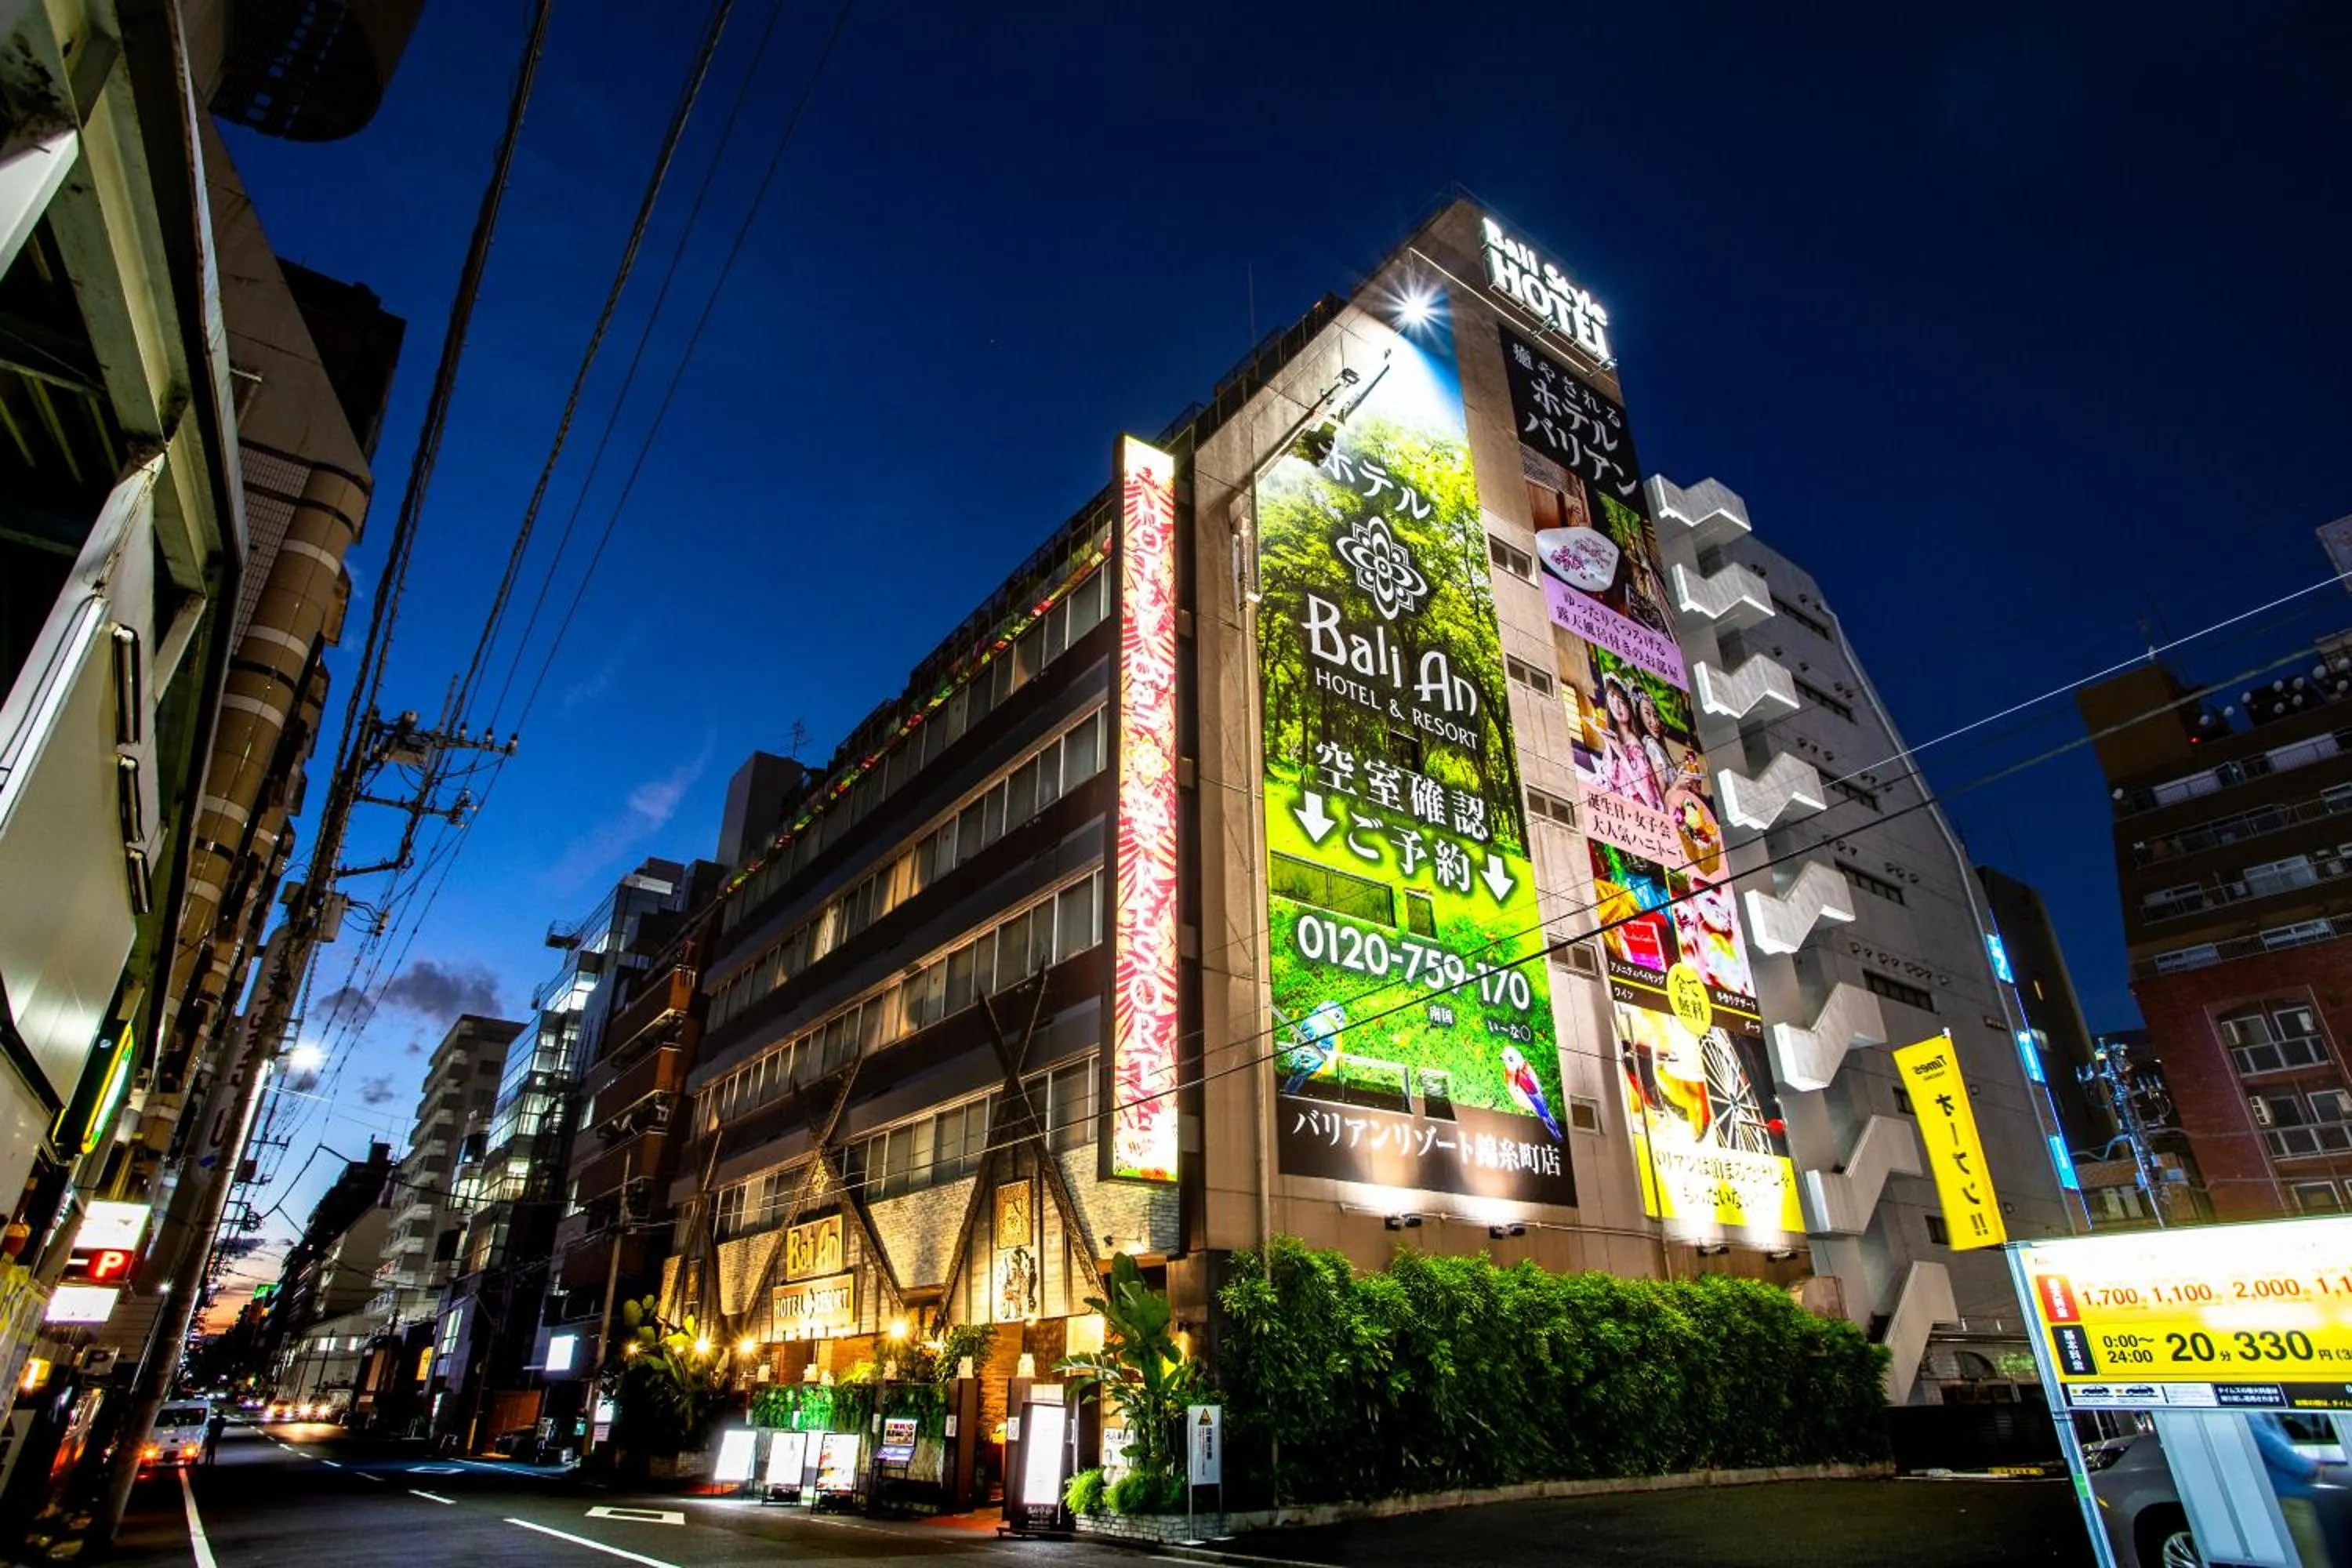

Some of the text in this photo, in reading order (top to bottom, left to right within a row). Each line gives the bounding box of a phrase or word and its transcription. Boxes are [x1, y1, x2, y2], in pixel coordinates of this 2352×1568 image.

[1490, 245, 1613, 363] HOTEL
[1525, 412, 1637, 497] バリアン
[1531, 379, 1618, 452] ホテル
[1319, 440, 1431, 520] ホテル
[1301, 593, 1477, 716] Bali An
[1316, 668, 1479, 750] HOTEL & RESORT
[1316, 740, 1489, 841] 空室確認
[1348, 811, 1472, 892] ご予約
[1298, 915, 1530, 1011] 0120-759-170
[95, 1250, 124, 1278] P
[2082, 1288, 2138, 1307] 1,700
[2152, 1284, 2212, 1304] 1,100
[2232, 1279, 2300, 1300] 2,000
[775, 1294, 804, 1318] HOTEL
[2107, 1350, 2154, 1364] 24:00
